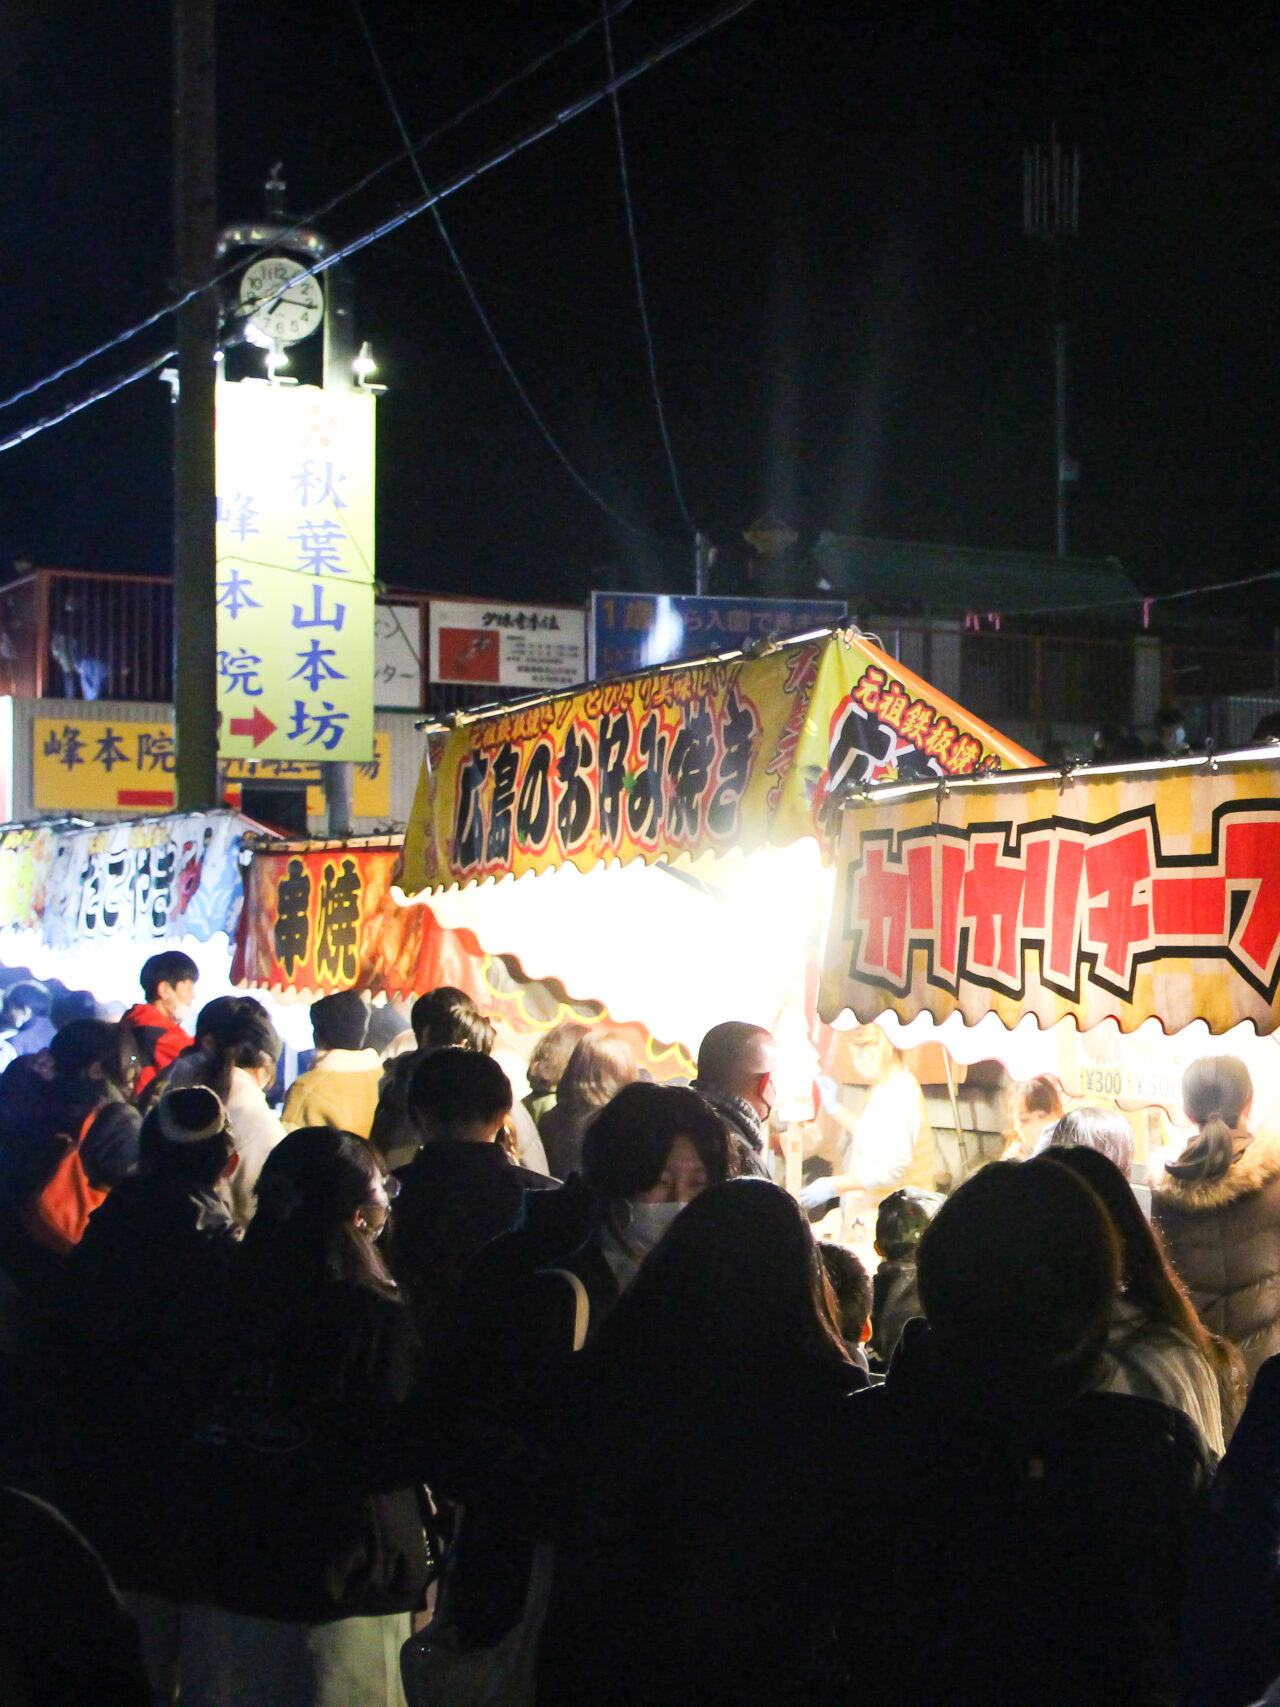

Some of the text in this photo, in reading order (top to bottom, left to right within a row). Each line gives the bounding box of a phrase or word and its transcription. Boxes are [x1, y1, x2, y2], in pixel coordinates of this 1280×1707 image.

[301, 283, 310, 295] 2
[276, 322, 285, 334] 6
[290, 320, 299, 331] 5
[300, 311, 309, 322] 4
[215, 490, 264, 697] 峰本院
[286, 458, 351, 751] 秋葉山本坊
[452, 684, 761, 872] 広島のお好み焼き
[274, 857, 363, 982] 串焼
[1085, 1069, 1122, 1095] ¥300
